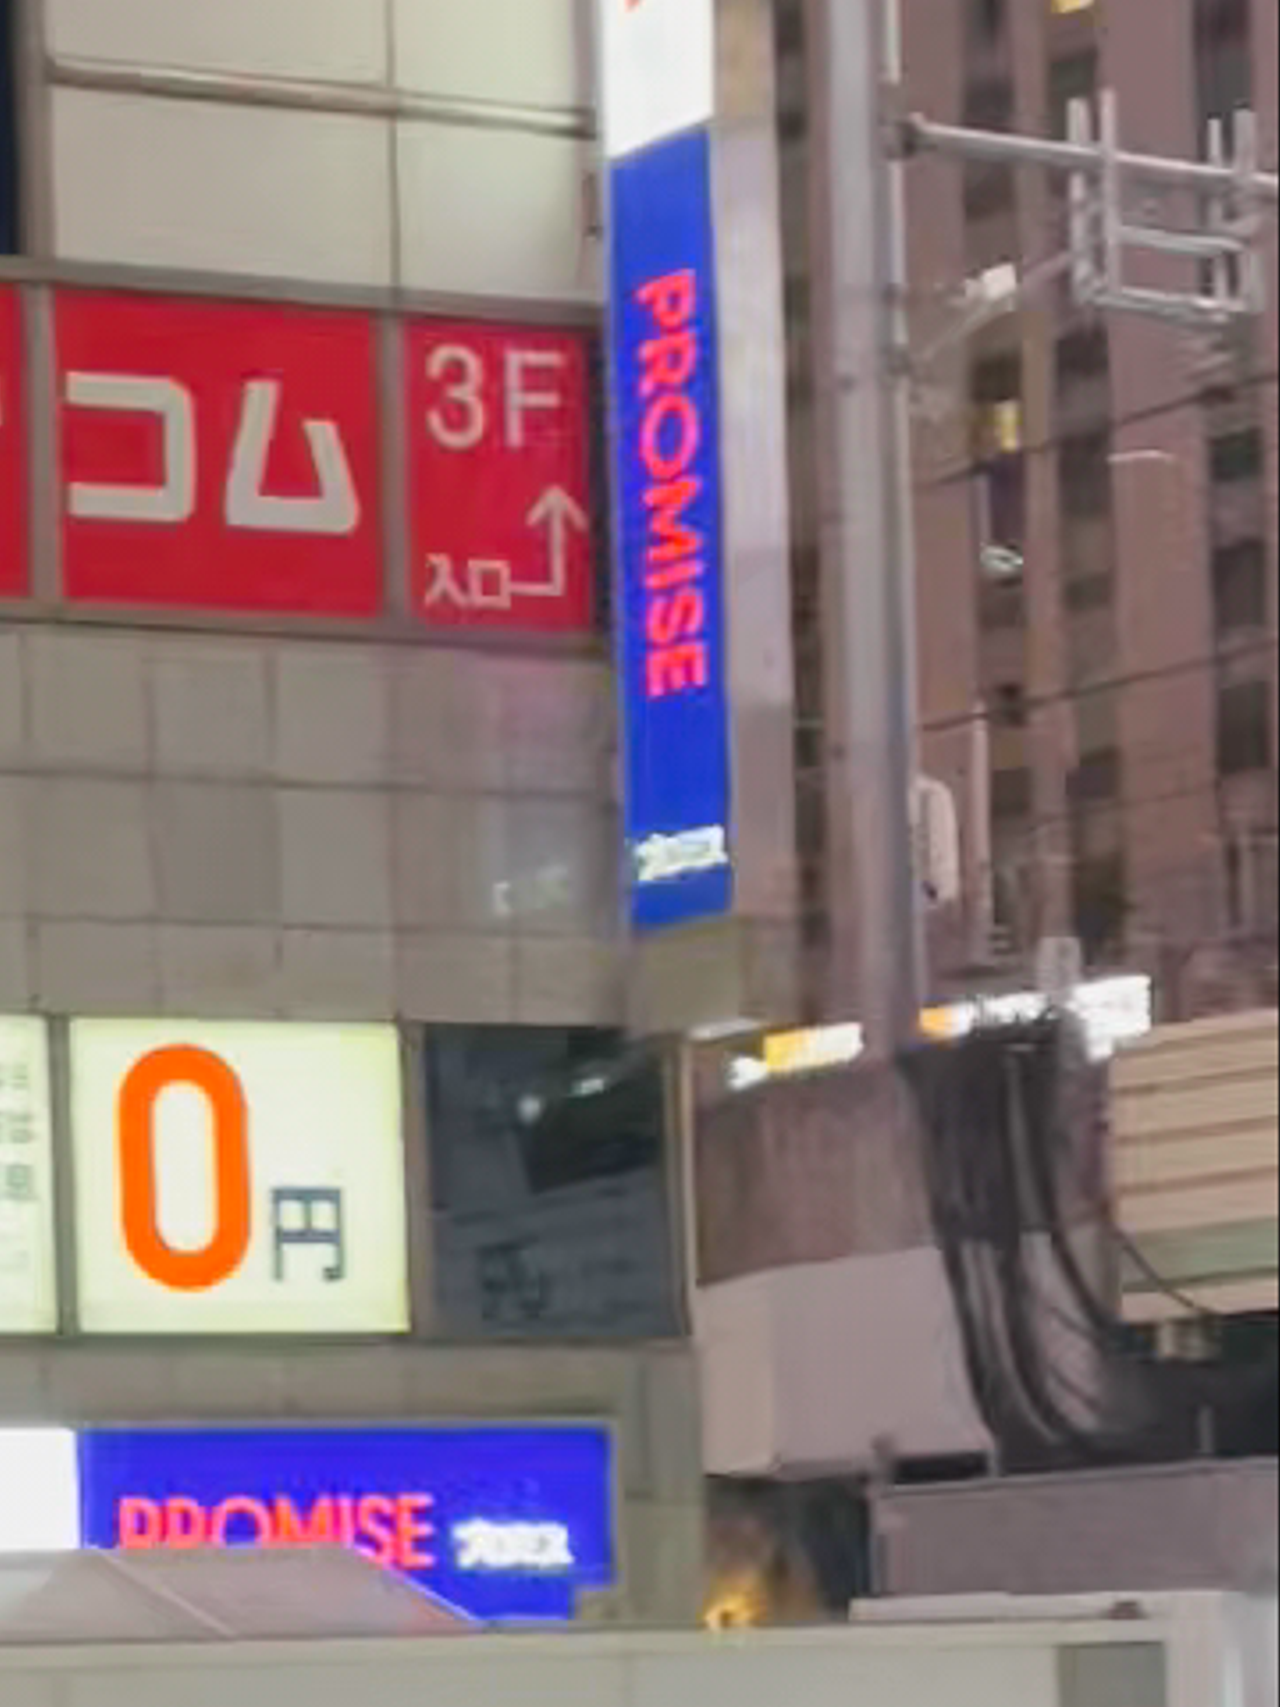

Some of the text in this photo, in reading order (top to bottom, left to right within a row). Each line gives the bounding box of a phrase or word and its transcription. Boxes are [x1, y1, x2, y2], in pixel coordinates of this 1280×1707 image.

[425, 344, 566, 450] 3F
[636, 267, 708, 698] PROMISE
[425, 554, 511, 608] 入口
[117, 1042, 344, 1292] 0円
